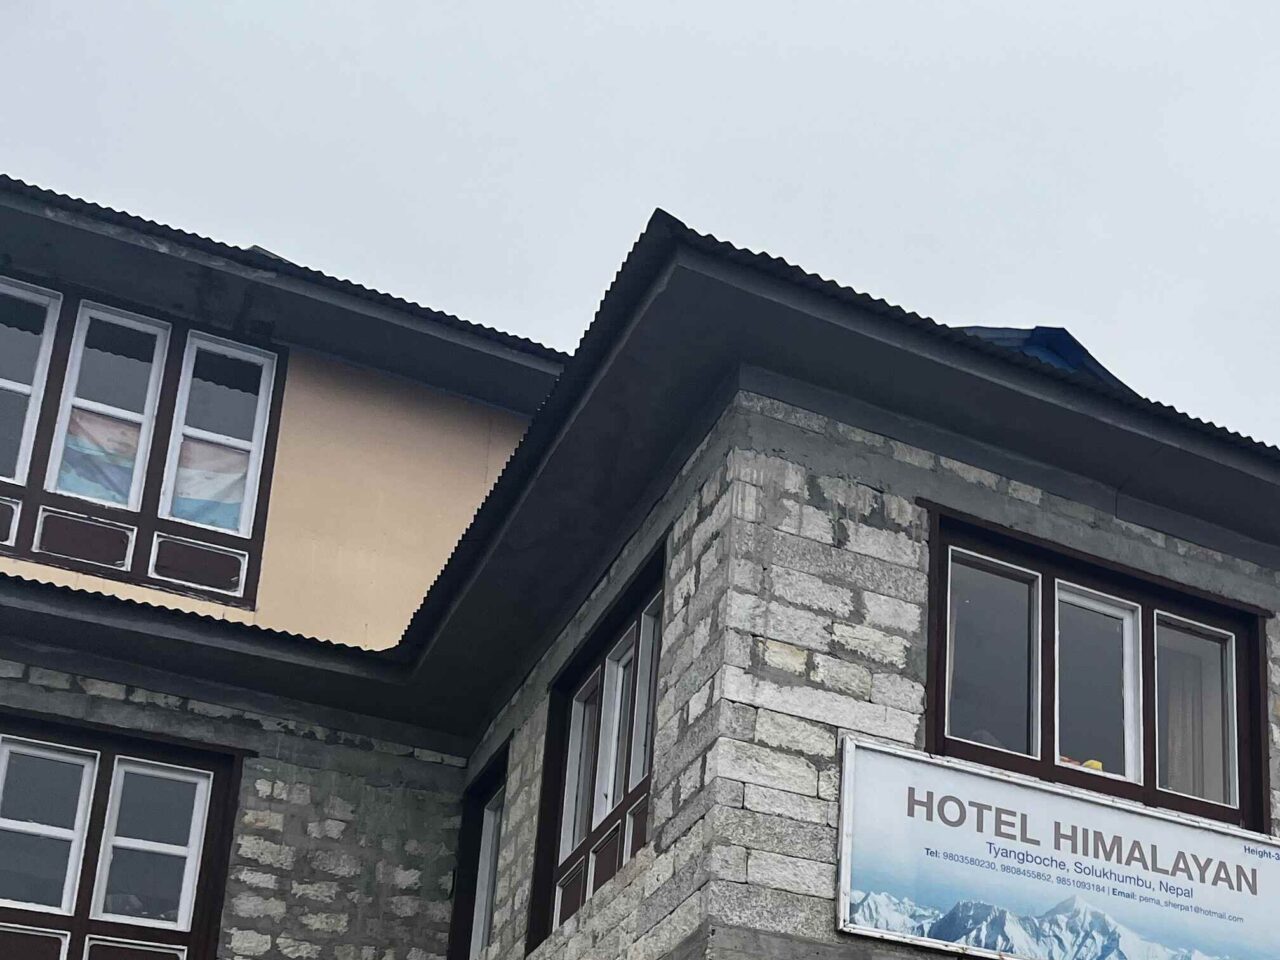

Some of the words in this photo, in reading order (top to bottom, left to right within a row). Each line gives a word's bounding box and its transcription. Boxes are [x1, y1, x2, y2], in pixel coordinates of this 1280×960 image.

[907, 786, 1041, 846] HOTEL
[1054, 821, 1258, 896] HIMALAYAN
[986, 841, 1070, 873] Tyangboche,
[1074, 861, 1155, 892] Solukhumbu,
[1159, 880, 1194, 899] Nepal
[925, 847, 940, 858] Tel:
[943, 851, 998, 871] 9803580230,
[1056, 875, 1106, 894] 9851093184
[1112, 888, 1137, 901] Email:
